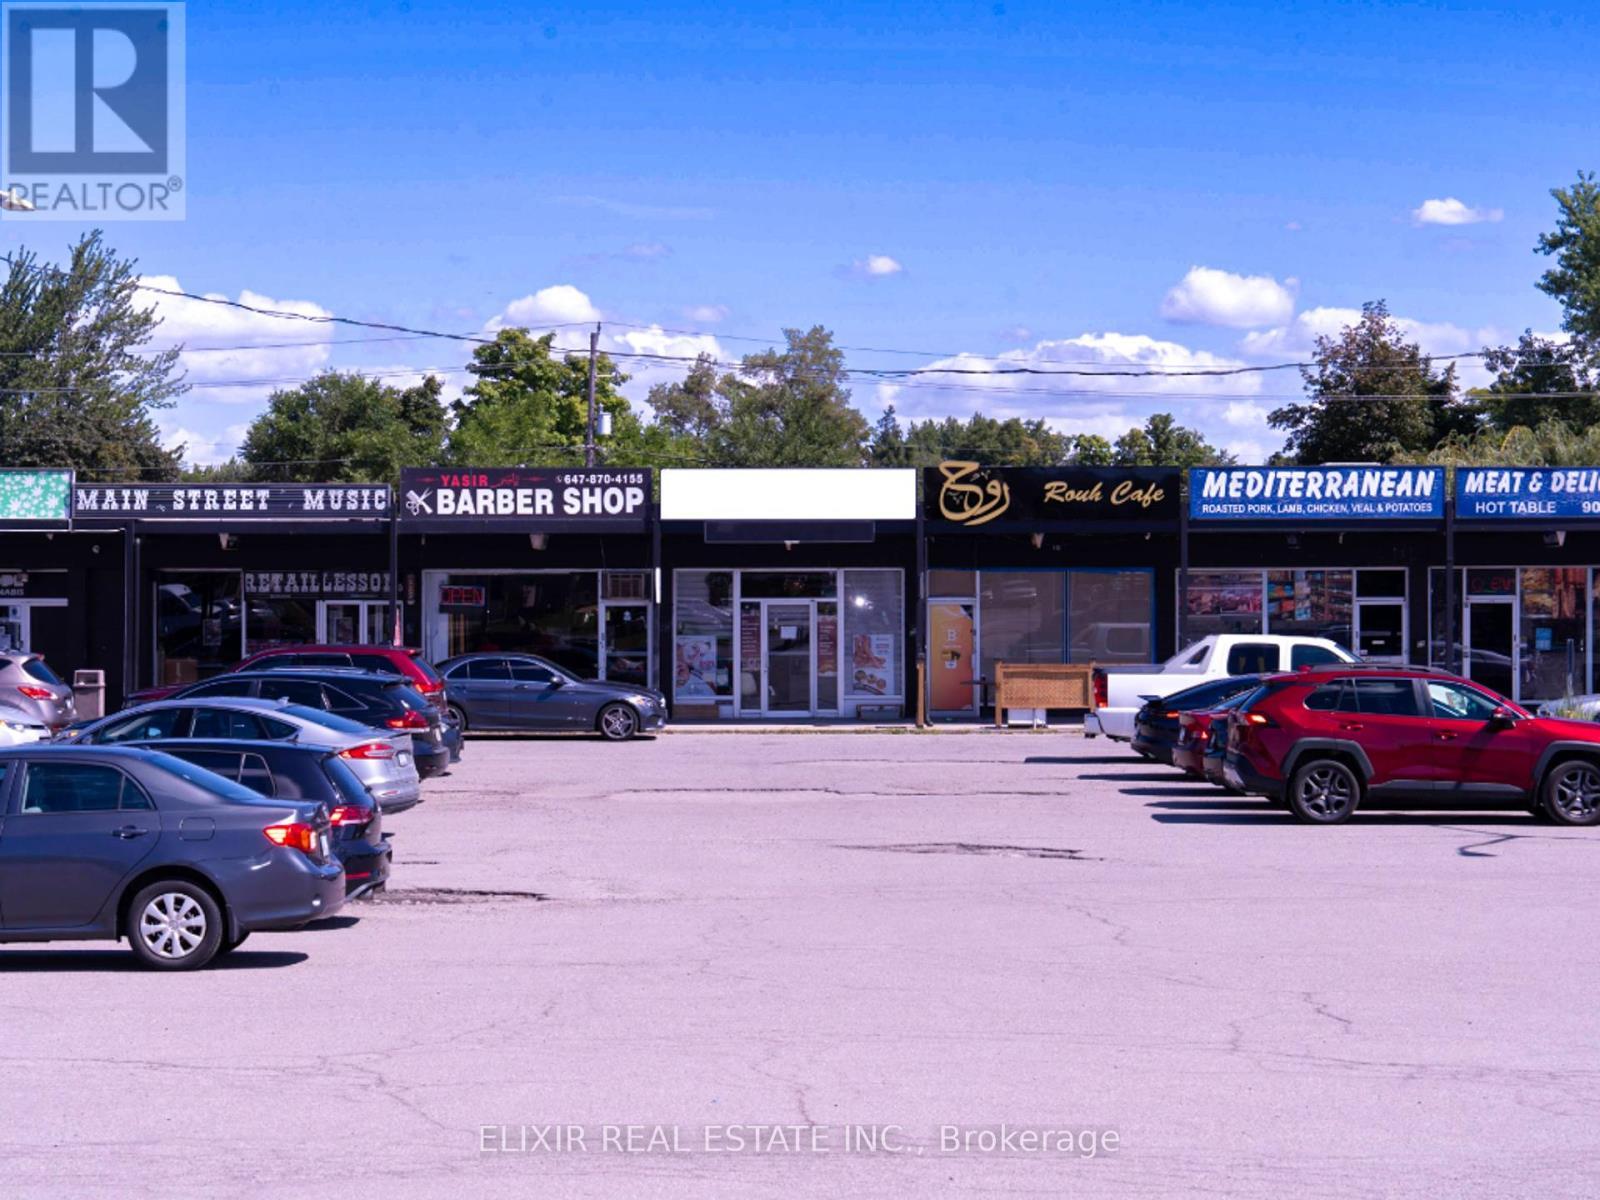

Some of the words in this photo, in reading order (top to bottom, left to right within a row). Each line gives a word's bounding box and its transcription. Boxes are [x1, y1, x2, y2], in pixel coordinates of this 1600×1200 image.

[441, 474, 489, 487] YASIR
[563, 474, 644, 485] 647-870-4155
[1202, 470, 1435, 499] MEDITERRANEAN
[1465, 471, 1525, 493] MEAT
[1528, 471, 1543, 493] &
[77, 489, 149, 510] MAIN
[173, 489, 270, 510] STREET
[303, 489, 387, 510] MUSIC
[436, 488, 554, 515] BARBER
[562, 486, 645, 515] SHOP
[1043, 480, 1103, 503] Rouh
[1110, 480, 1165, 508] Cafe
[1202, 504, 1246, 513] ROASTED
[1247, 504, 1276, 514] PORK,
[1277, 504, 1306, 514] LAMB,
[1307, 504, 1349, 514] CHICKEN,
[1351, 503, 1375, 512] VEAL
[1377, 503, 1384, 512] &
[1385, 503, 1433, 512] POTATOES
[1475, 501, 1506, 513] HOT
[1509, 501, 1557, 513] TABLE
[245, 573, 320, 593] RETAIL
